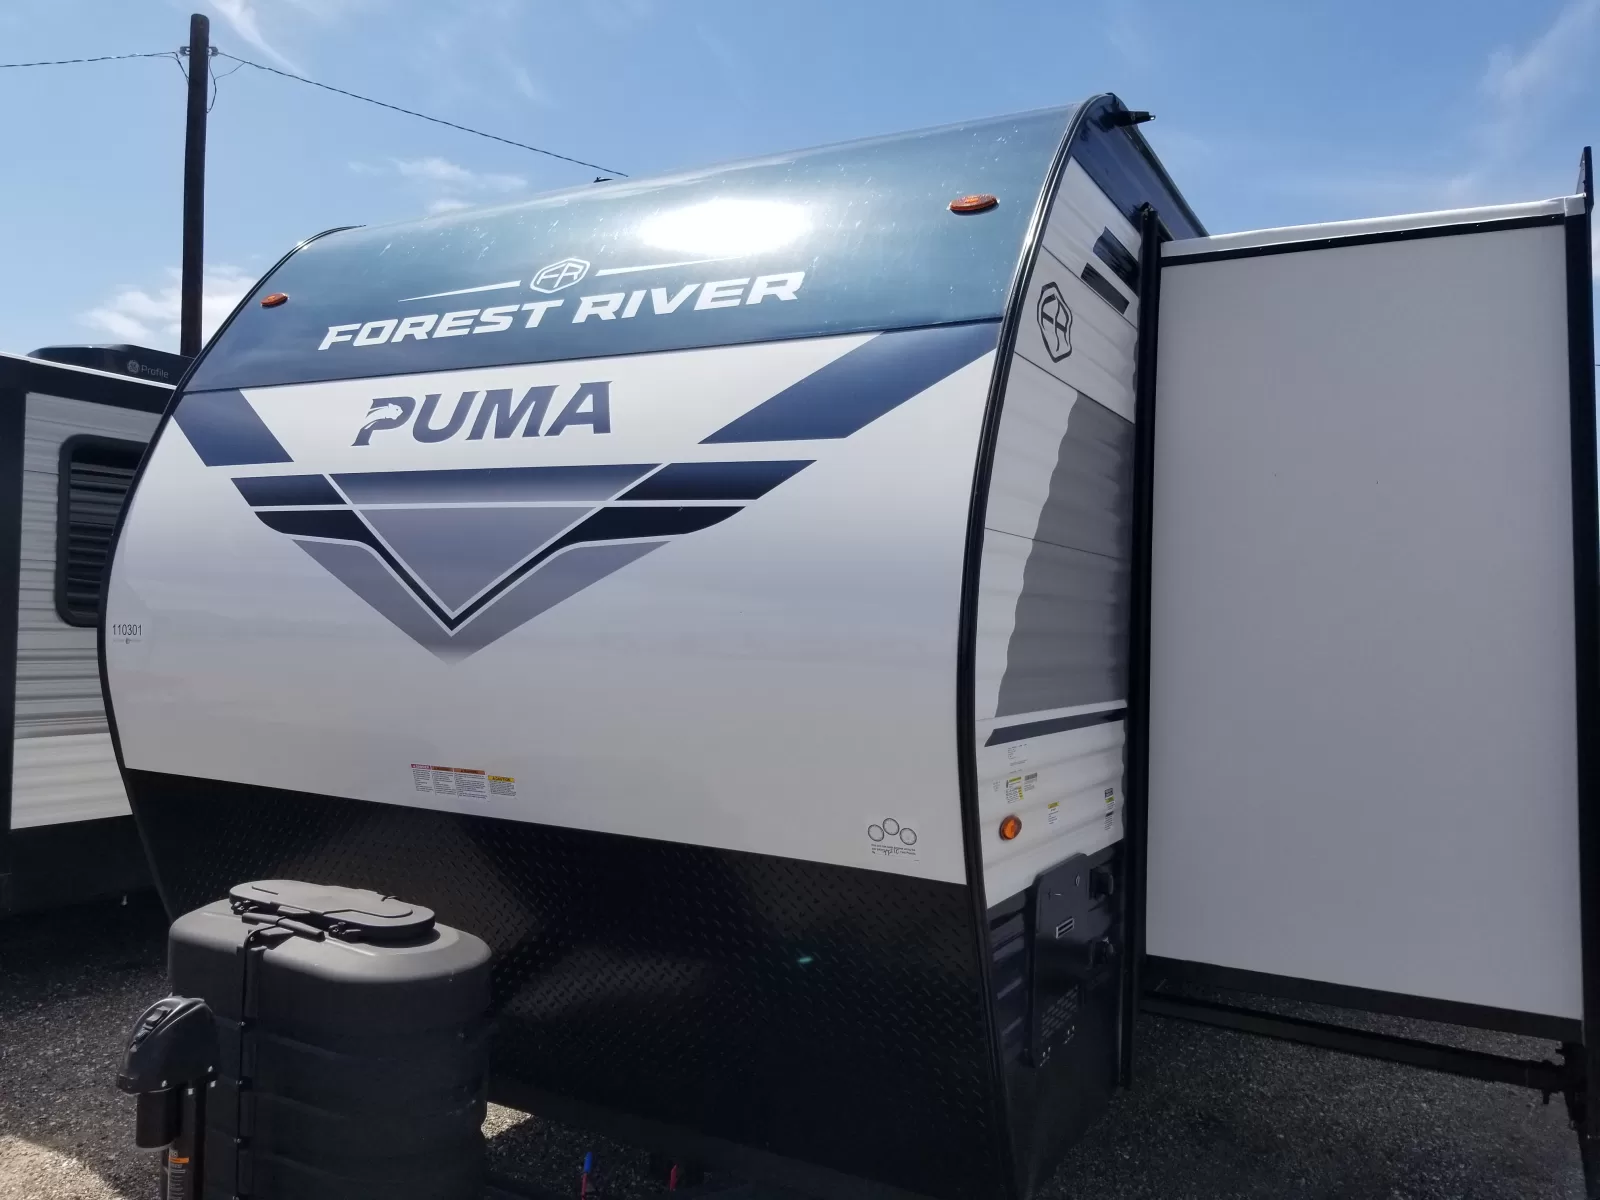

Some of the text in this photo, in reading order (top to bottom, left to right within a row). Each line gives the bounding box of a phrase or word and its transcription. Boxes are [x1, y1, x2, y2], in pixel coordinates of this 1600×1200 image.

[317, 271, 806, 351] FOREST RIVER
[141, 364, 169, 379] Profile
[350, 380, 613, 447] PUMA
[112, 623, 142, 637] 110301
